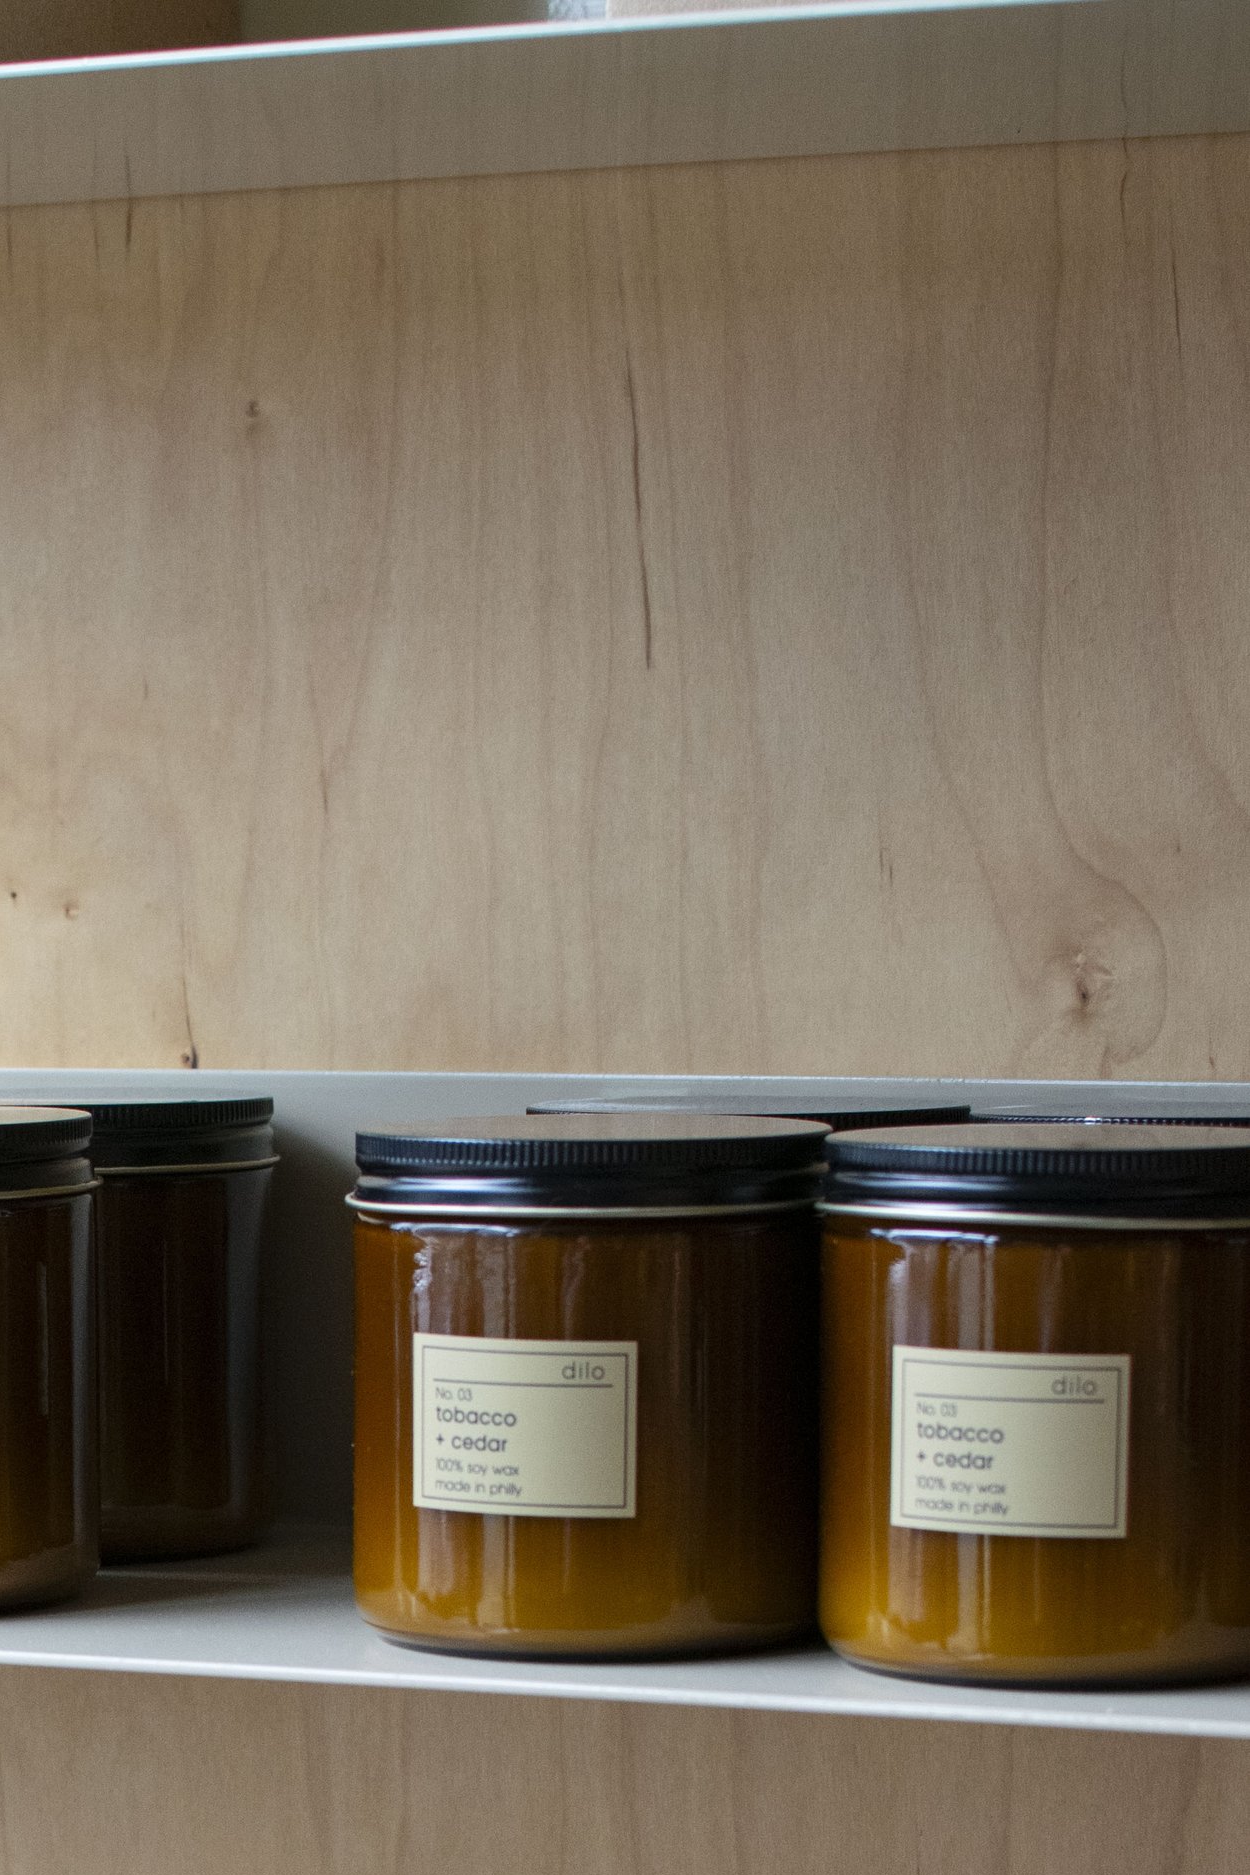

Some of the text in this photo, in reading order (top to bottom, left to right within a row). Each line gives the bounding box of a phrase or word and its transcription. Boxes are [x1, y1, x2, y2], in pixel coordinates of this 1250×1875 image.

[562, 1362, 605, 1380] dilo
[457, 1388, 472, 1401] 03
[1051, 1376, 1097, 1396] dilo
[436, 1407, 517, 1427] tobacco
[917, 1422, 1004, 1444] tobacco
[436, 1434, 507, 1452] + cedar
[436, 1457, 519, 1476] 100% soy wax
[917, 1451, 994, 1470] + cedar
[435, 1479, 522, 1498] made in philly
